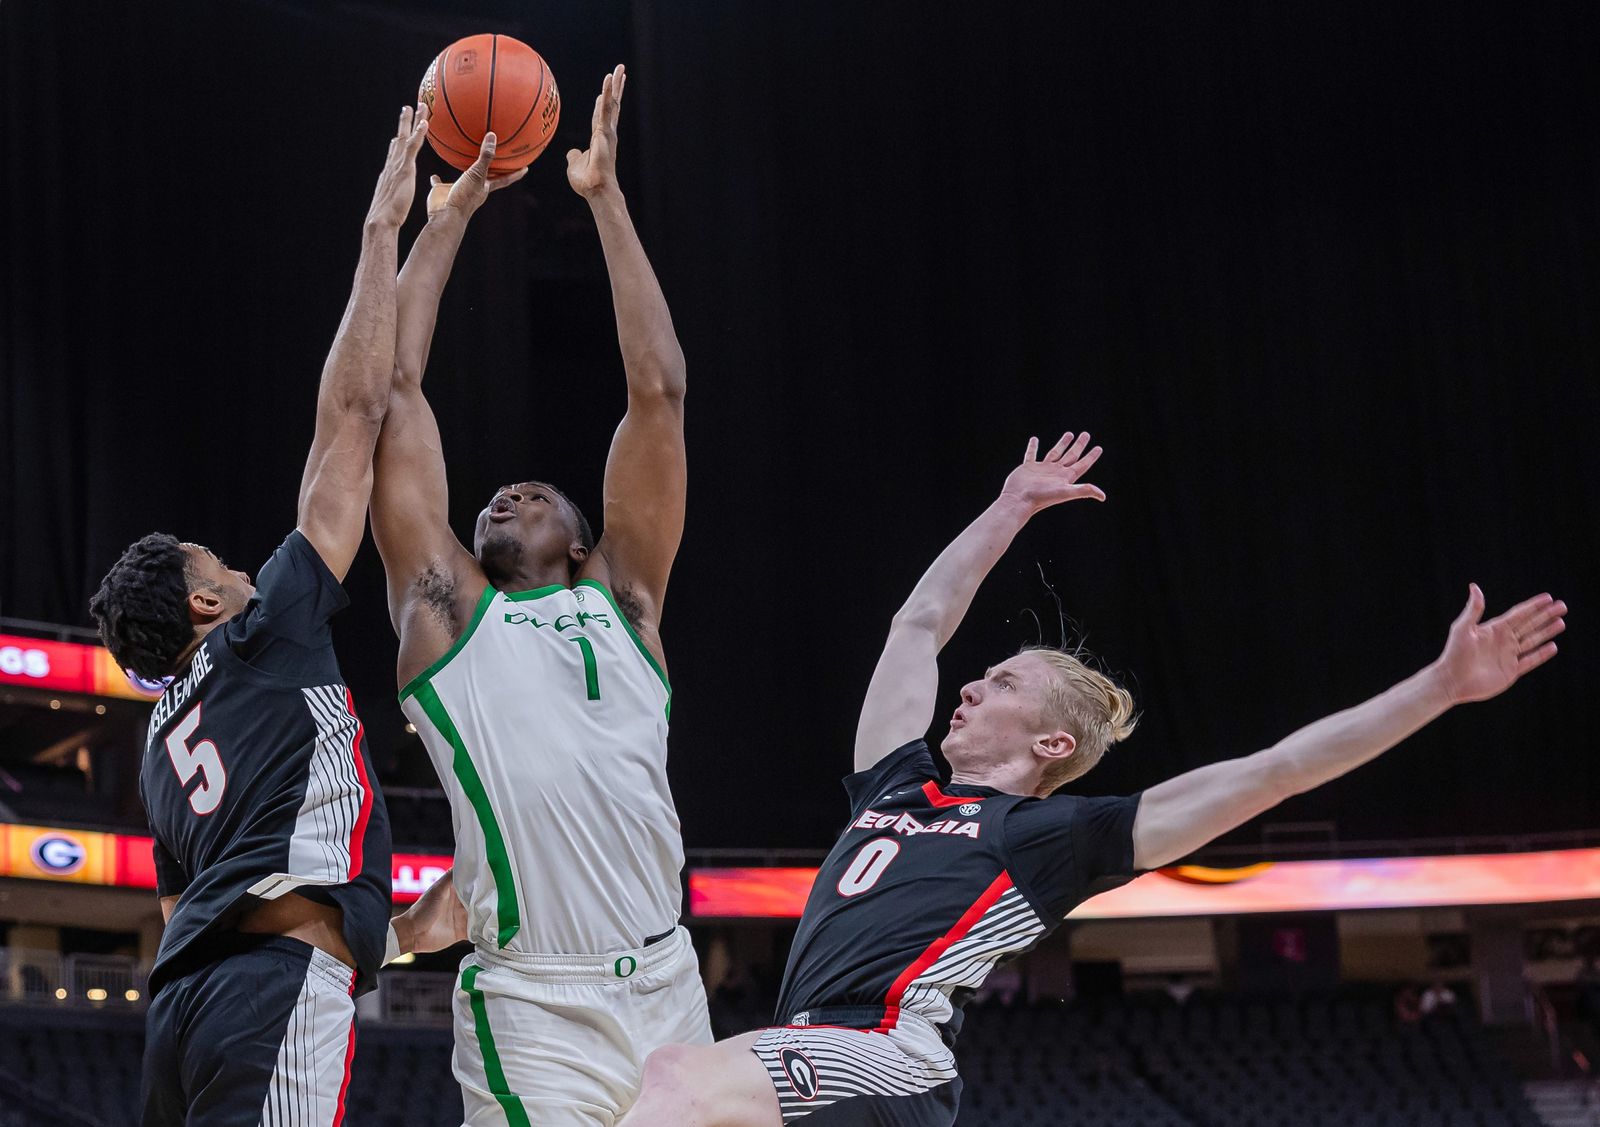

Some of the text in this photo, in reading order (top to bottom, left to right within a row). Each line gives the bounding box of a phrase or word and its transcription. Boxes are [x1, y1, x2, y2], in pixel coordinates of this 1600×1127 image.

[504, 611, 611, 632] DUCKS
[568, 637, 600, 700] 1
[164, 700, 227, 816] 5
[846, 810, 980, 839] EORGIA
[38, 838, 87, 868] G
[838, 837, 899, 895] 0
[614, 956, 637, 978] O
